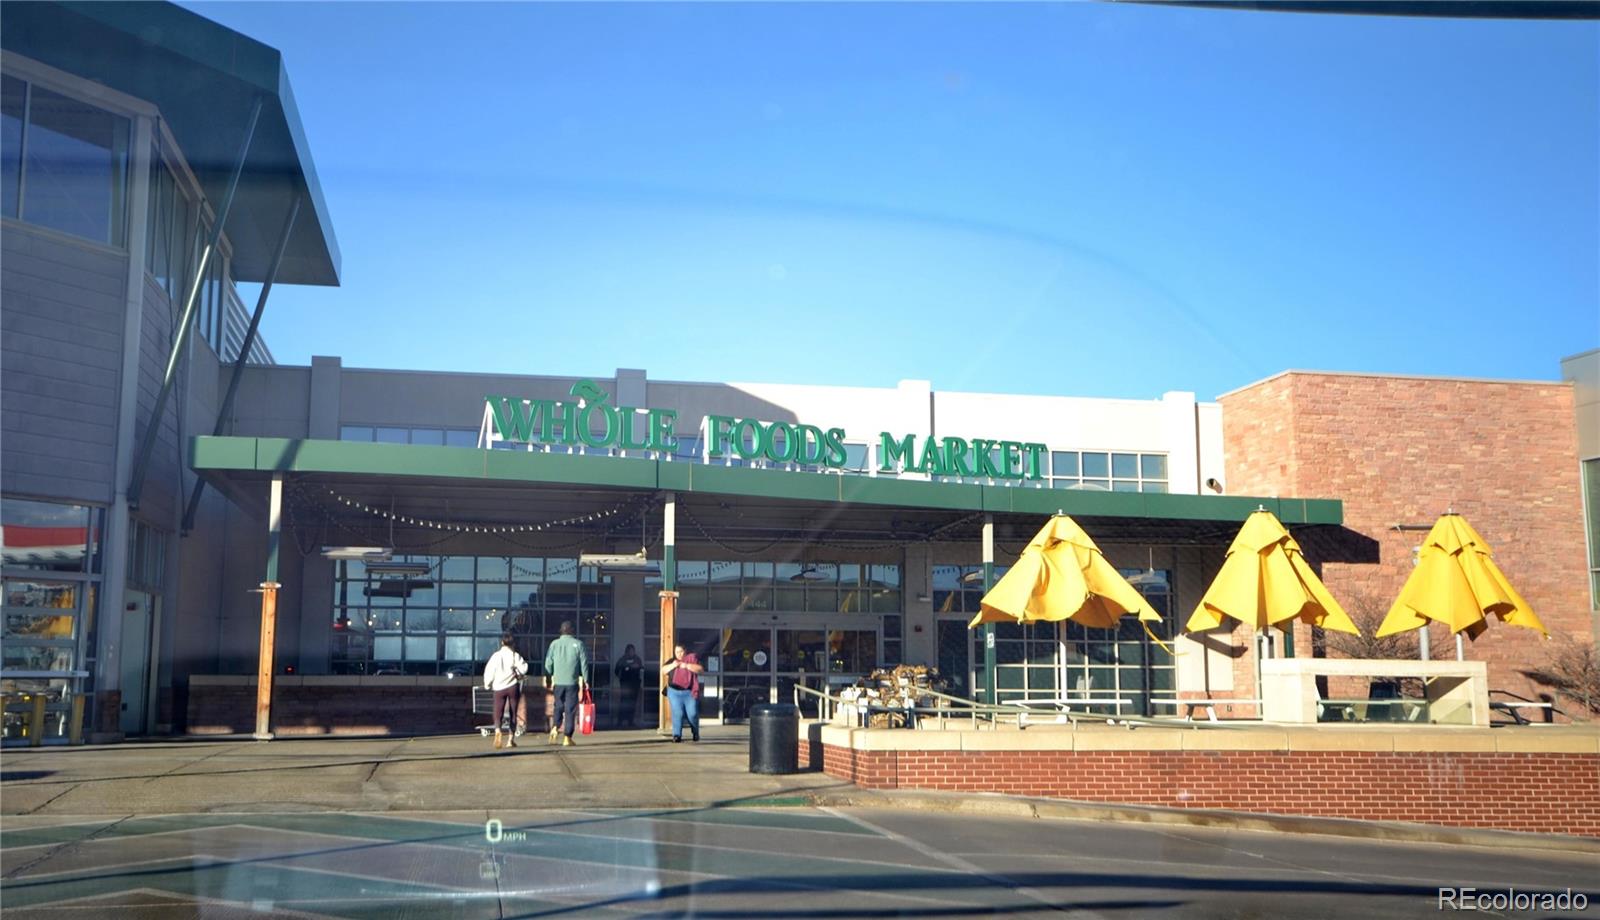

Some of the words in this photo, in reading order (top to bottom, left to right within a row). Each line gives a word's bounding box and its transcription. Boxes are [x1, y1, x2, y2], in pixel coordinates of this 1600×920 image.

[485, 392, 678, 450] WHOLE
[709, 415, 846, 466] FOODS
[879, 431, 1048, 480] MARKET
[486, 819, 502, 842] 0
[504, 832, 527, 841] MPH
